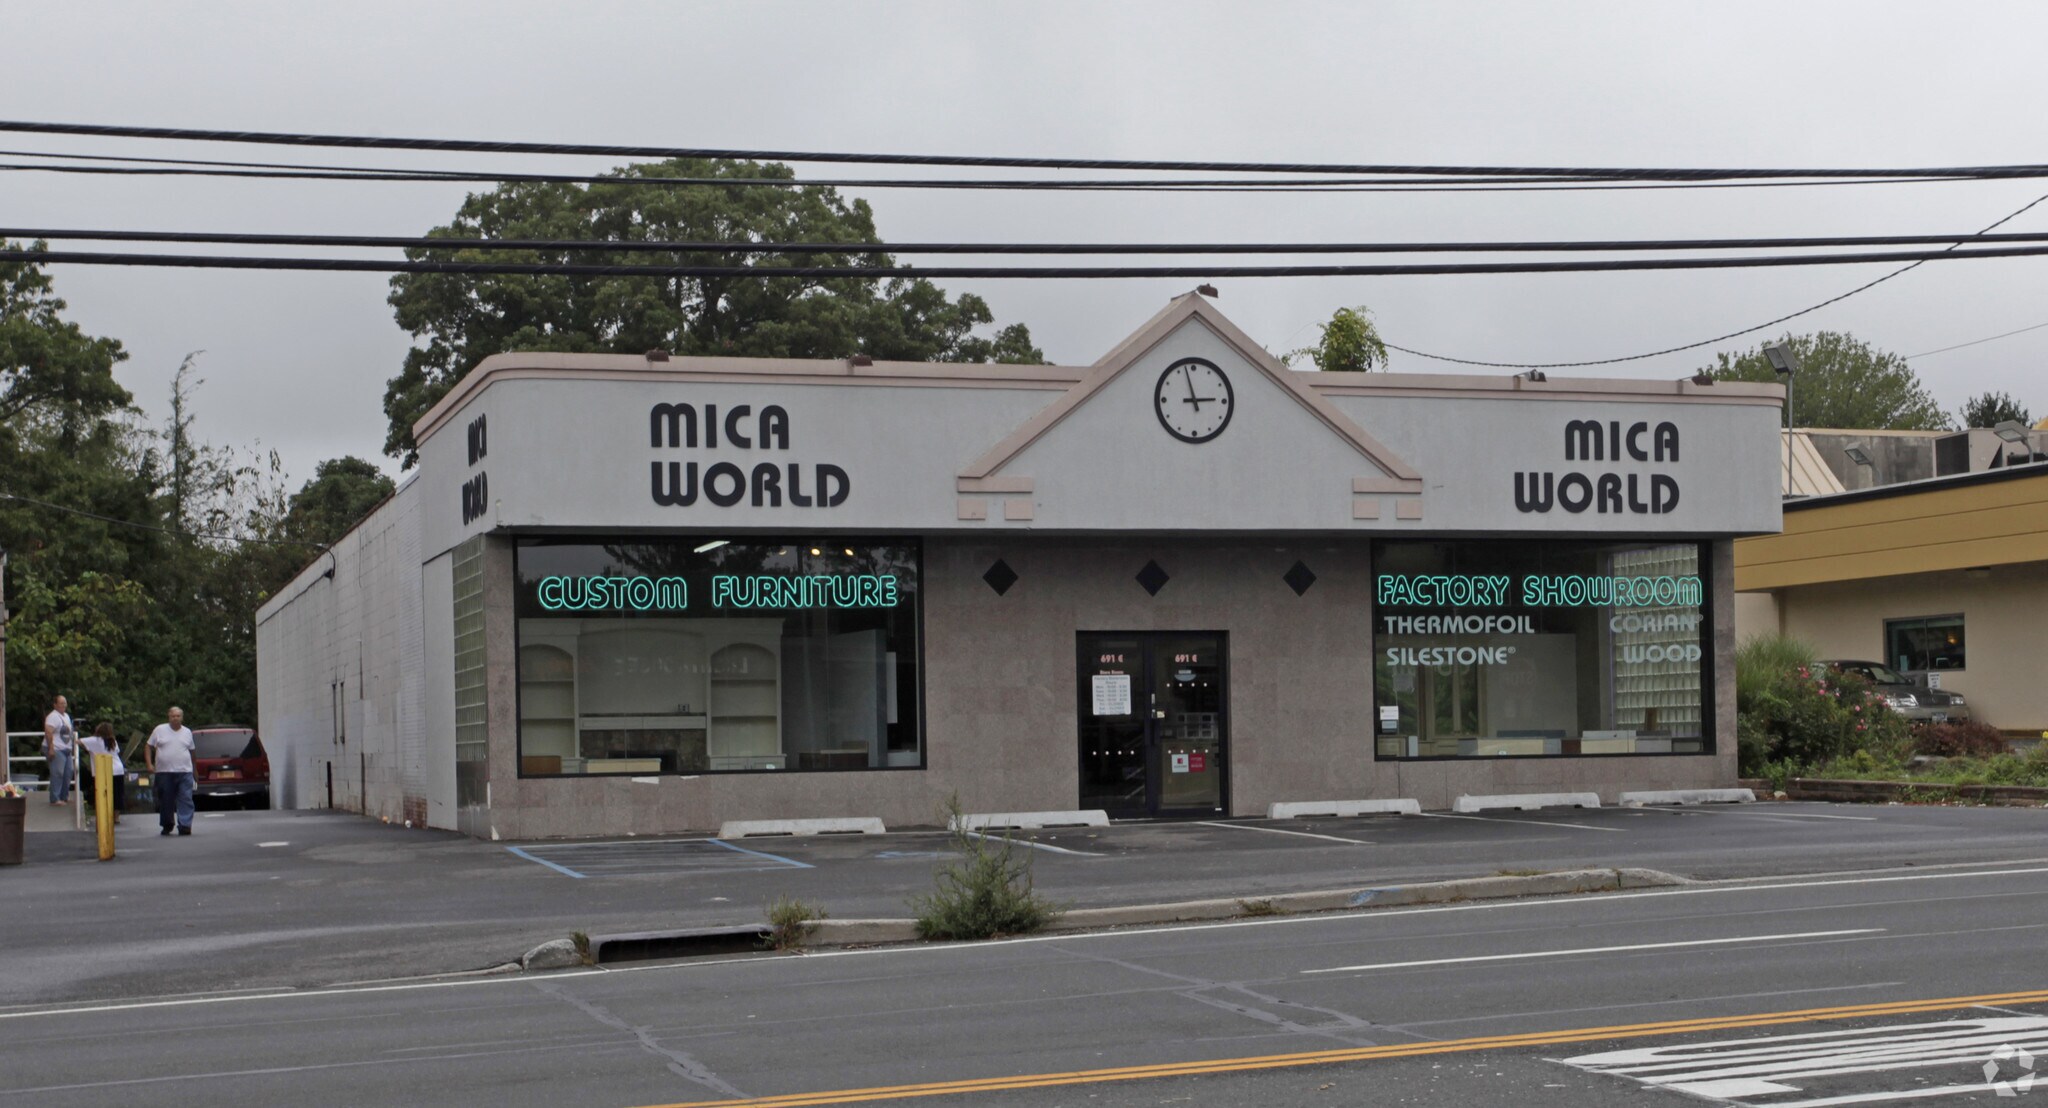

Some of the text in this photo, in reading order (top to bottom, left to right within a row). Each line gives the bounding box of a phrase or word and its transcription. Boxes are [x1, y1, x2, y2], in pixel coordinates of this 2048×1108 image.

[650, 402, 790, 450] MICA
[1564, 419, 1680, 463] MICA
[650, 461, 851, 508] WORLD
[1514, 471, 1680, 514] WORLD
[537, 574, 898, 610] CUSTOM FURNITURE
[1377, 574, 1703, 607] FACTORY SHOWROOM
[1384, 615, 1535, 634] THERMOFOIL
[1100, 654, 1115, 663] 691
[1174, 654, 1189, 663] 691
[1623, 644, 1702, 664] WOOD
